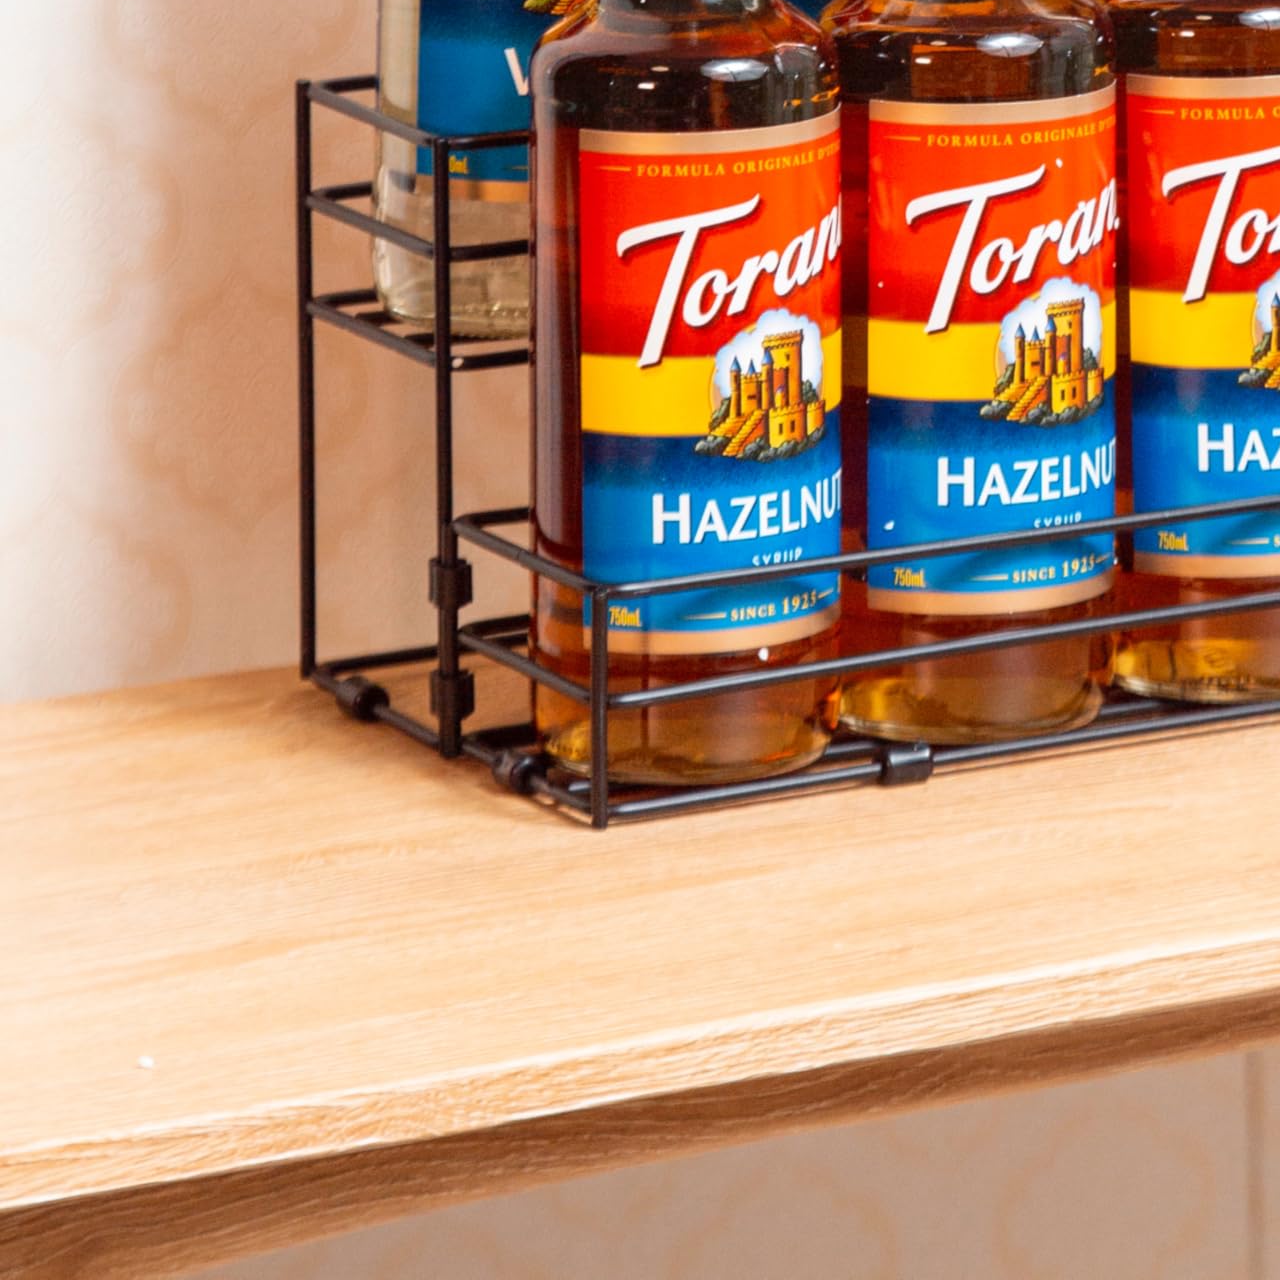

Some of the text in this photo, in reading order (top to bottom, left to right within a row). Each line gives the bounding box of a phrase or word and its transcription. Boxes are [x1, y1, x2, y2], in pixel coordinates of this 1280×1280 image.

[1180, 107, 1265, 120] FORMULA
[927, 133, 1013, 147] FORMULA
[1020, 122, 1096, 144] ORIGINALE
[636, 164, 725, 177] FORMULA
[733, 150, 814, 174] ORIGINALE
[905, 164, 1117, 333] Toran
[1158, 530, 1189, 552] 750mL
[893, 567, 926, 588] 750mL
[1012, 566, 1056, 584] SINCE
[609, 606, 642, 627] 750mL
[730, 604, 776, 622] SINCE
